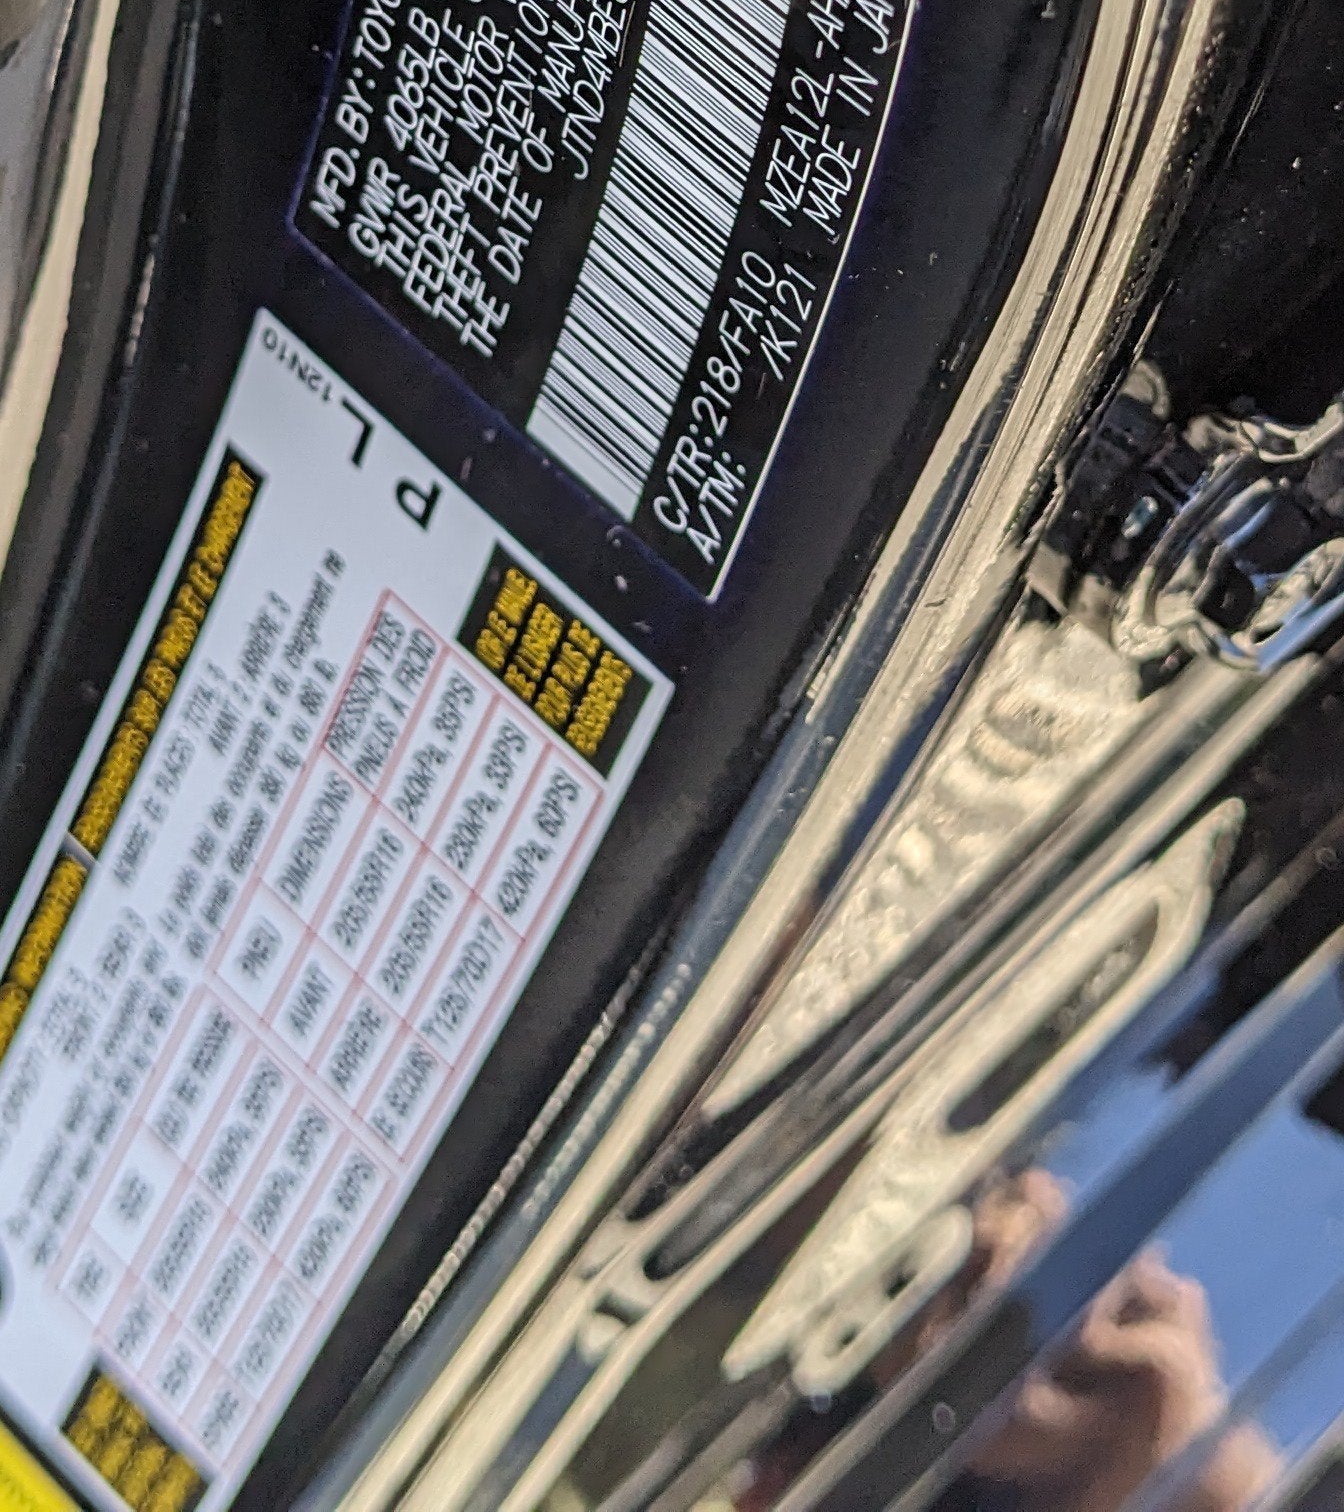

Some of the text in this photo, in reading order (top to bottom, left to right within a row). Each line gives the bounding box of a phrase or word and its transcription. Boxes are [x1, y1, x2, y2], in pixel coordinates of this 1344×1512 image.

[347, 154, 401, 259] GVWR
[384, 5, 441, 152] 4065LB
[375, 181, 430, 279] THIS
[410, 8, 476, 175] VEHICLE
[404, 157, 478, 314] FEDERAL
[454, 14, 509, 145] MOTOR
[461, 281, 511, 360] THE
[488, 185, 544, 286] DATE
[519, 111, 561, 175] OF
[432, 210, 495, 331] THEFT
[685, 449, 750, 567] A/TM:
[802, 122, 864, 235] MADE
[835, 56, 880, 117] IN
[341, 401, 374, 467] L
[394, 479, 441, 529] P
[275, 769, 355, 905] DIMENSIONS
[326, 656, 386, 759] PRESSION
[370, 610, 406, 661] DES
[353, 712, 398, 786] PNEUS
[396, 625, 440, 696] FROID
[281, 957, 335, 1043] AVANT
